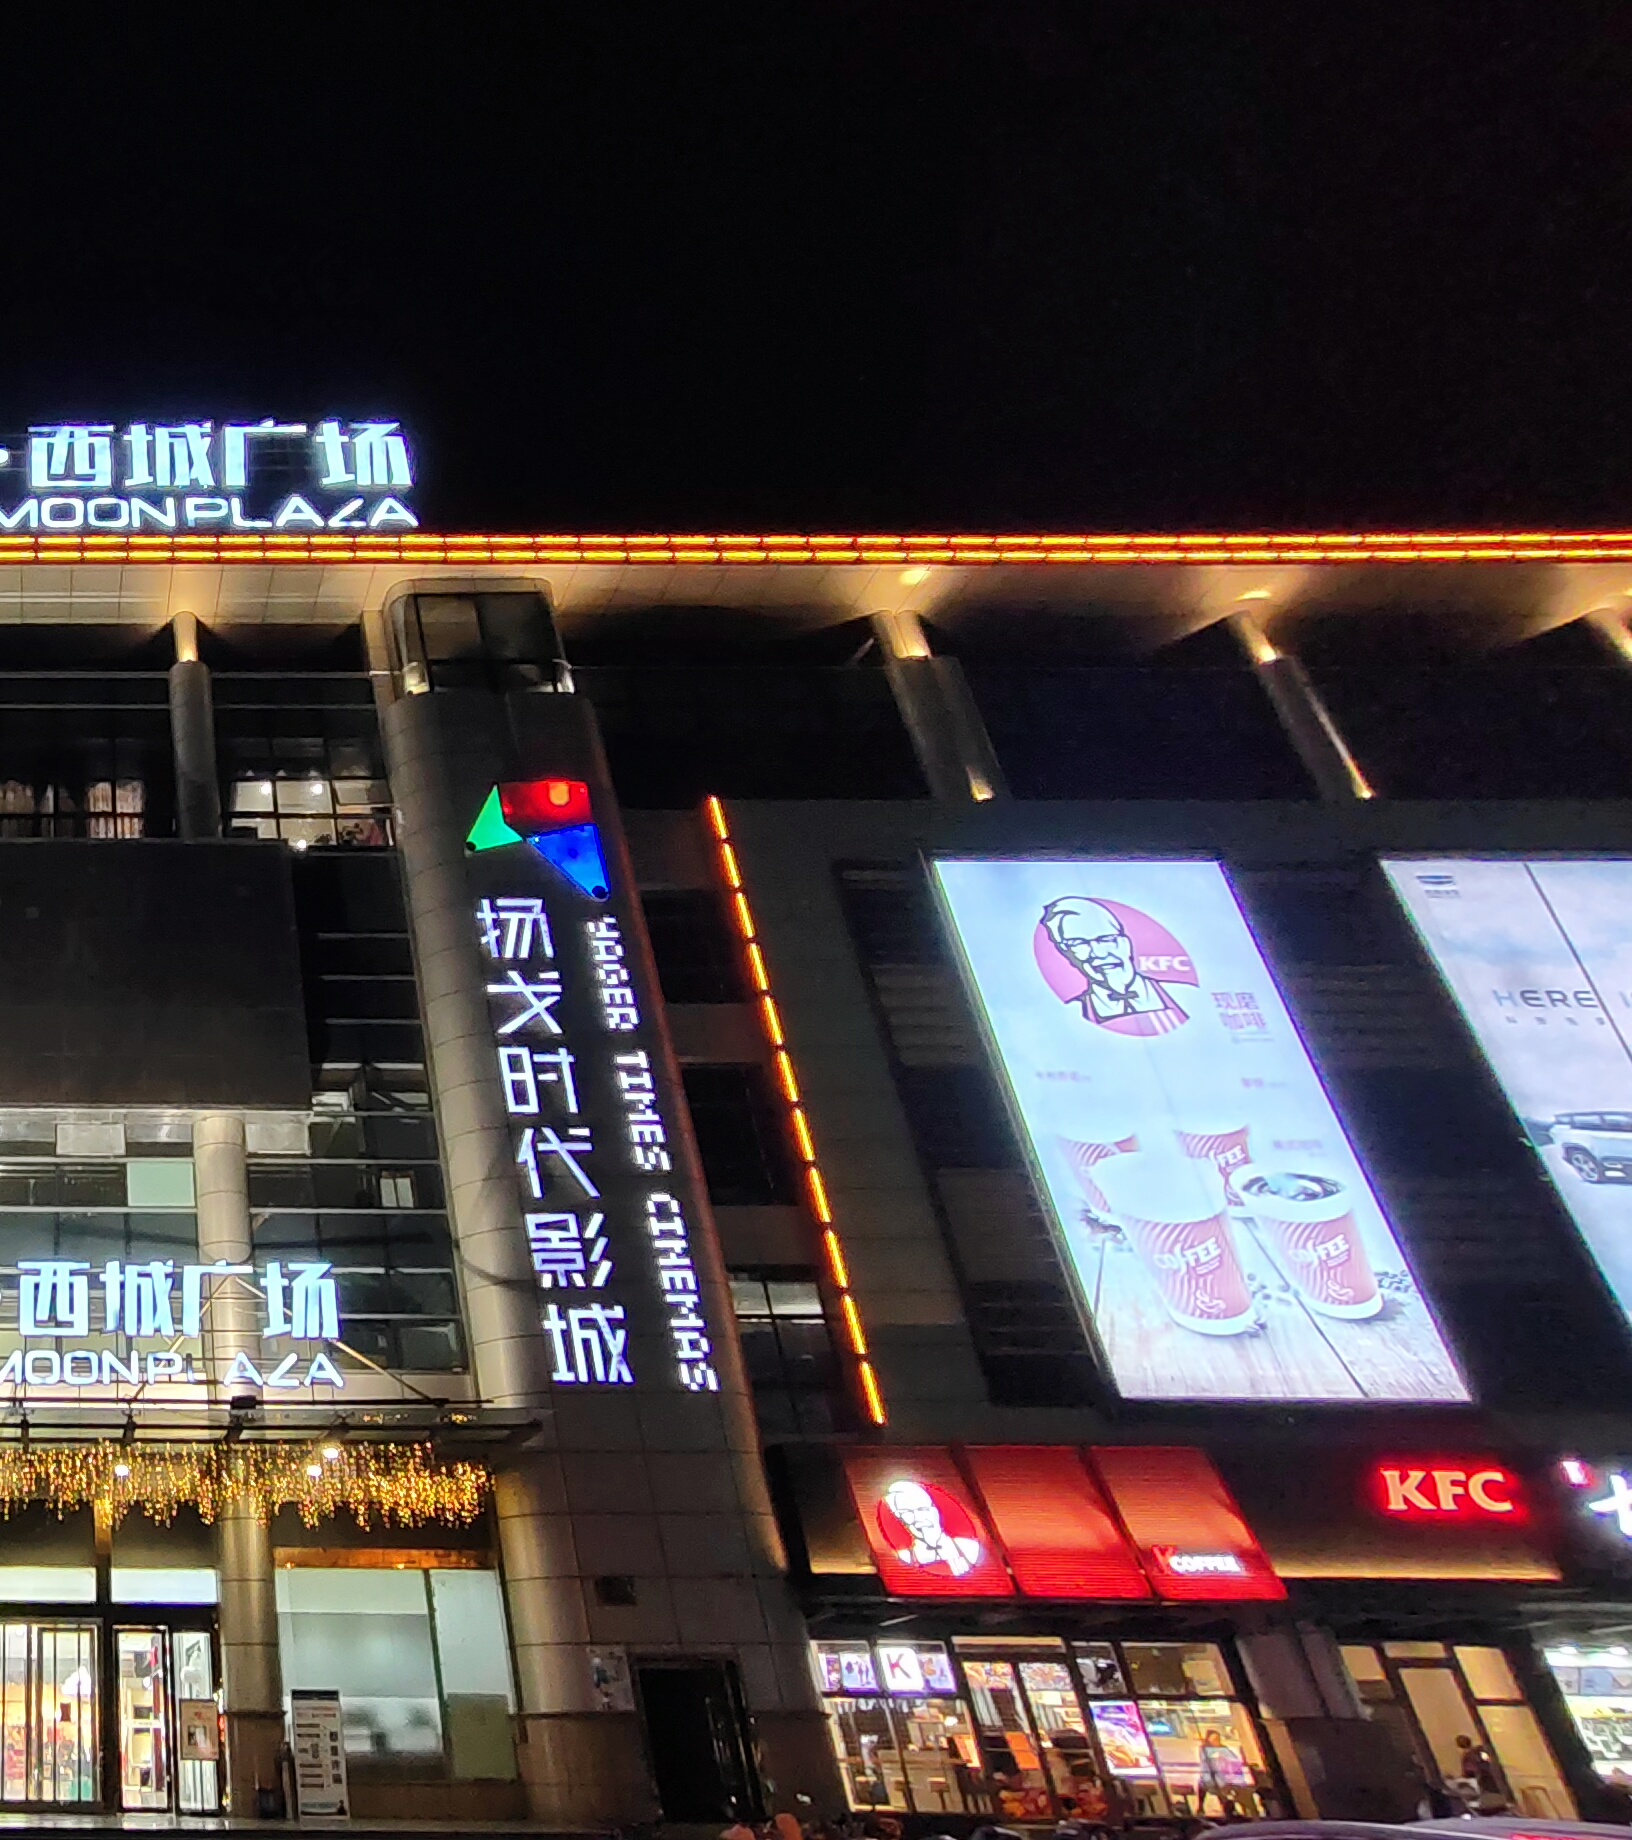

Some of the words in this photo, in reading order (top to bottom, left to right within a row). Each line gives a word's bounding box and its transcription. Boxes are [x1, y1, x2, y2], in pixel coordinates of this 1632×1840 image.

[1138, 955, 1191, 971] KFC
[1492, 989, 1600, 1009] HERE
[475, 897, 635, 1384] 扬戈时代影城
[585, 914, 641, 1031] YAGER
[614, 1050, 672, 1172] TIMES
[646, 1192, 722, 1393] CINEMAS
[1380, 1469, 1515, 1512] KFC
